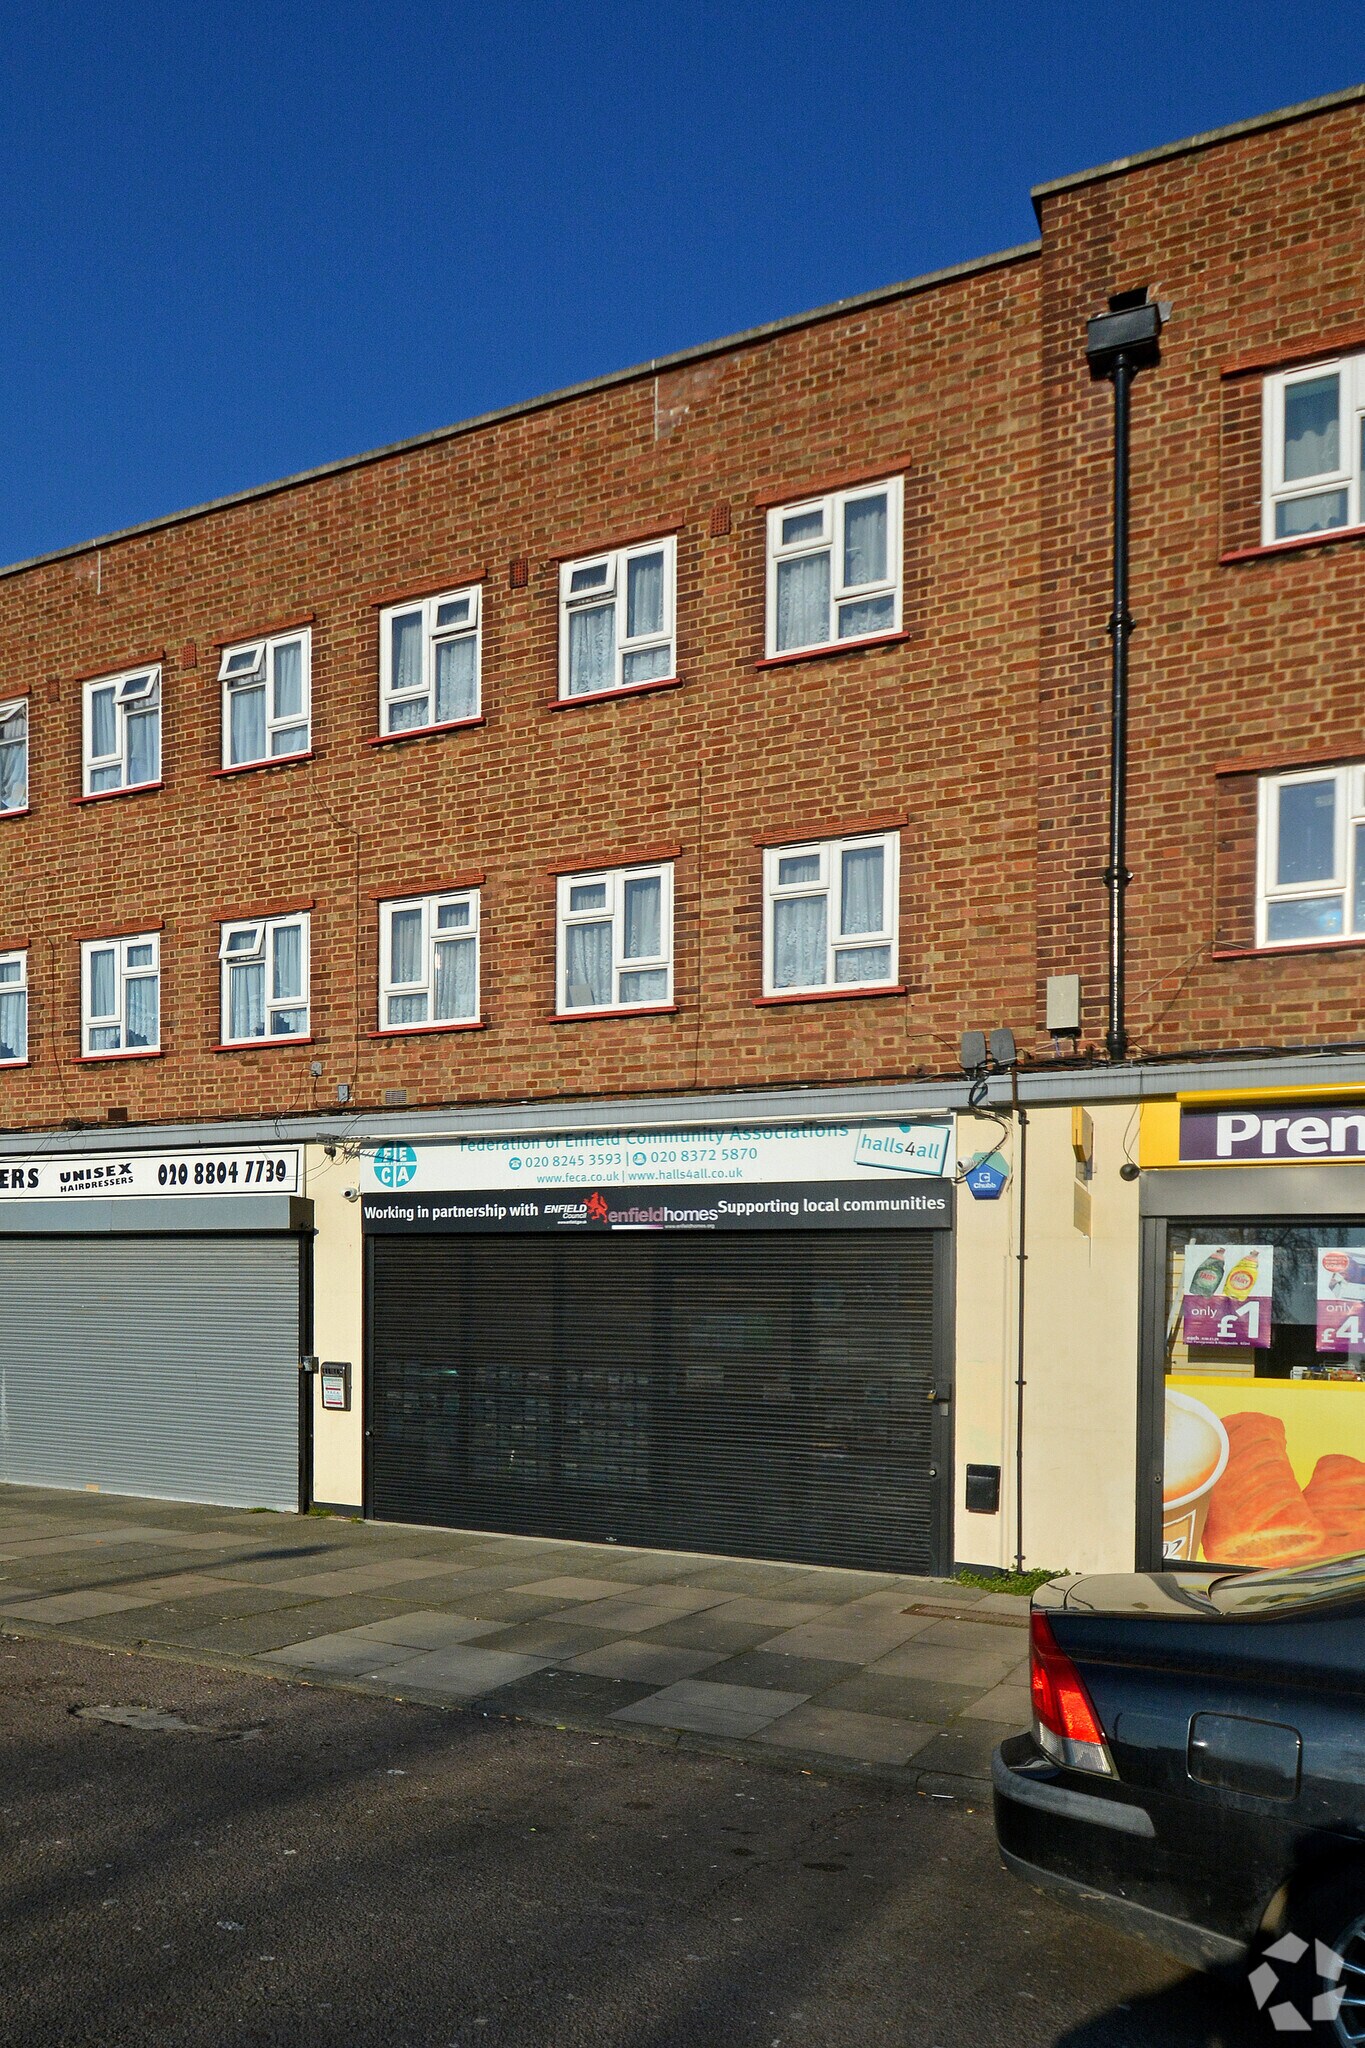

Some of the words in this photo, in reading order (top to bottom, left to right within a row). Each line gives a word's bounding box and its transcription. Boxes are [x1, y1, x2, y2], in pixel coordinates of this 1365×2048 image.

[460, 1136, 540, 1152] Federation
[546, 1133, 560, 1149] of
[566, 1131, 620, 1147] Enfield
[627, 1127, 725, 1145] Community
[730, 1123, 849, 1140] Associations
[860, 1134, 940, 1160] halls4all
[525, 1157, 549, 1168] 020
[552, 1155, 585, 1167] 8245
[589, 1153, 622, 1166] 3593
[651, 1151, 677, 1163] 020
[681, 1149, 717, 1162] 8372
[721, 1148, 758, 1161] 5870
[0, 1168, 39, 1189] ERS
[60, 1163, 132, 1183] UNISEX
[157, 1163, 188, 1186] 020
[194, 1161, 239, 1185] 8804
[536, 1171, 619, 1183] www.feca.co.uk
[628, 1167, 743, 1181] www.halls4all.co.uk
[60, 1176, 134, 1193] HAIRDRESSERS
[364, 1206, 414, 1221] Working
[417, 1205, 429, 1218] in
[432, 1205, 506, 1220] partnership
[509, 1203, 539, 1217] with
[544, 1204, 587, 1213] ENFIELD
[608, 1206, 718, 1222] enfieldhomes
[718, 1200, 799, 1215] Supporting
[803, 1199, 839, 1212] local
[843, 1196, 945, 1211] communities
[1191, 1307, 1218, 1318] only
[1326, 1303, 1354, 1314] only
[1217, 1301, 1260, 1338] £1
